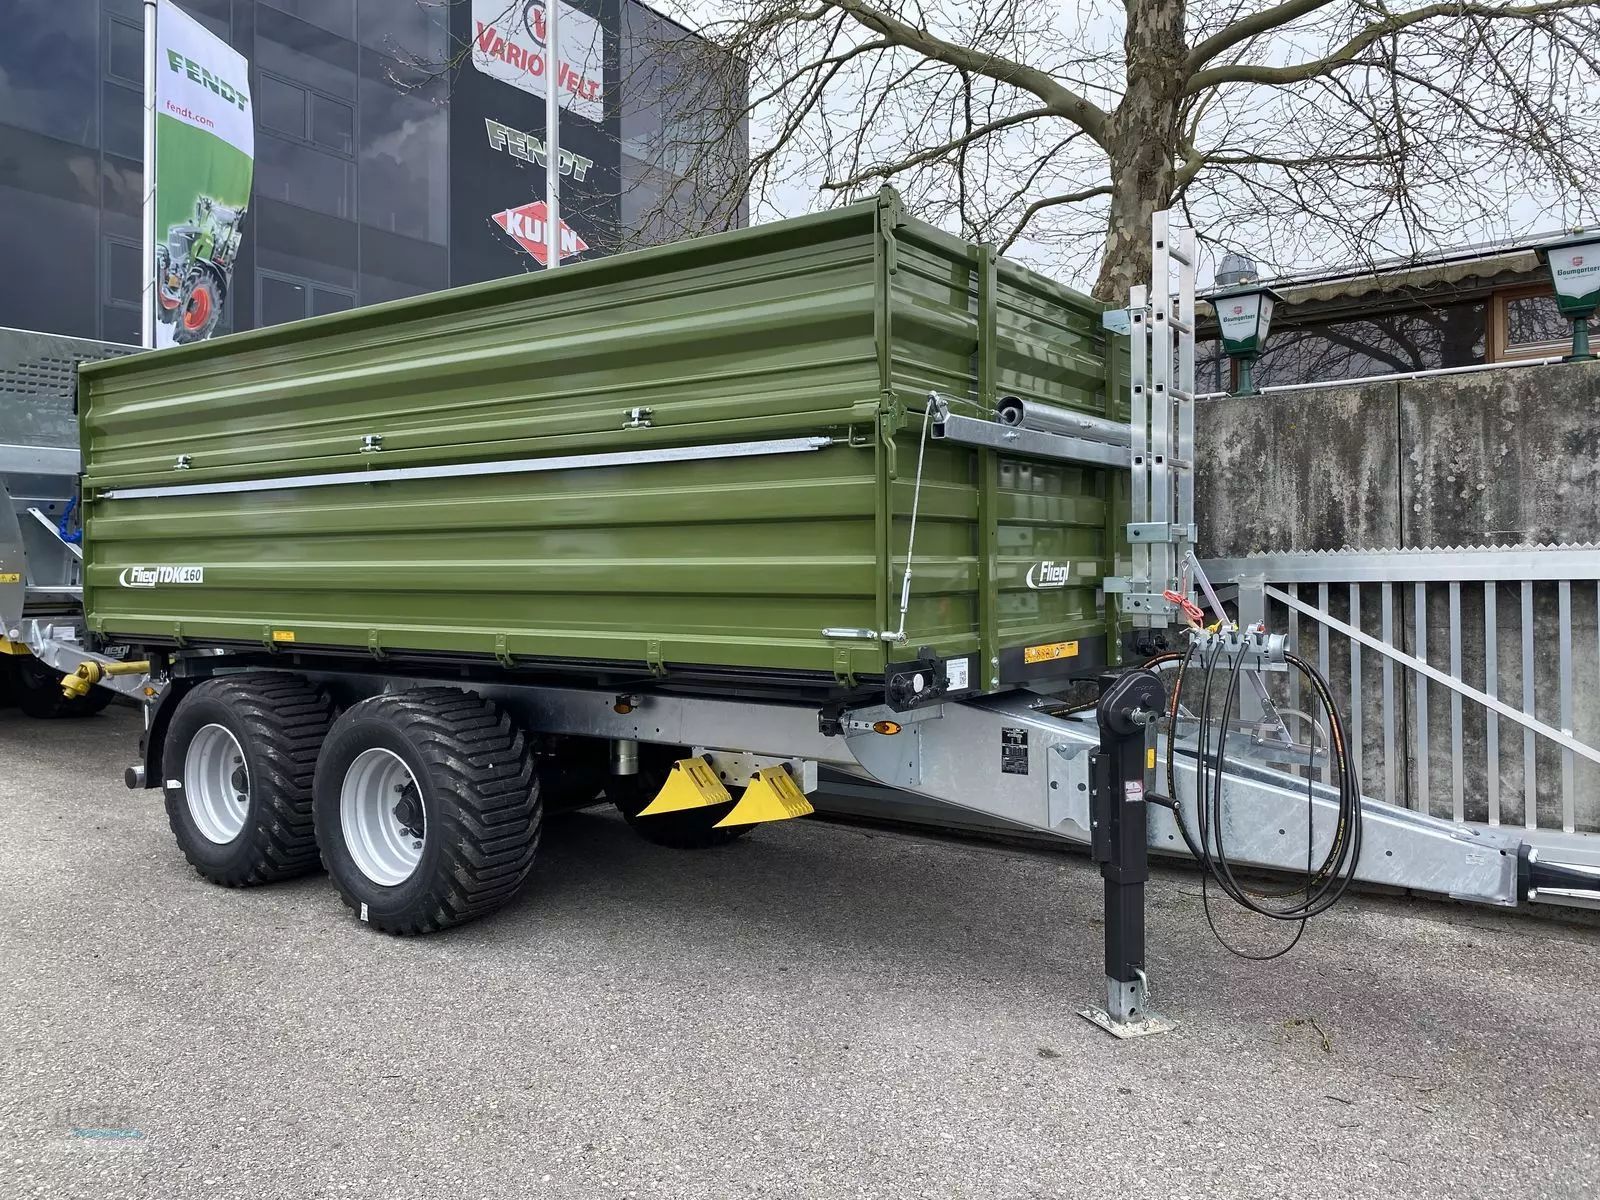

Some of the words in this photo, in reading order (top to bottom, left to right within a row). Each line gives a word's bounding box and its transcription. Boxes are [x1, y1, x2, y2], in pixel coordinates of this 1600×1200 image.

[166, 47, 249, 112] FENDT
[166, 100, 214, 128] fendt.com
[484, 117, 594, 182] FENDT
[506, 208, 577, 253] KUN
[130, 566, 160, 587] Fliegl
[159, 566, 182, 583] TDK
[184, 569, 201, 581] 160
[1038, 561, 1071, 586] Fliegl
